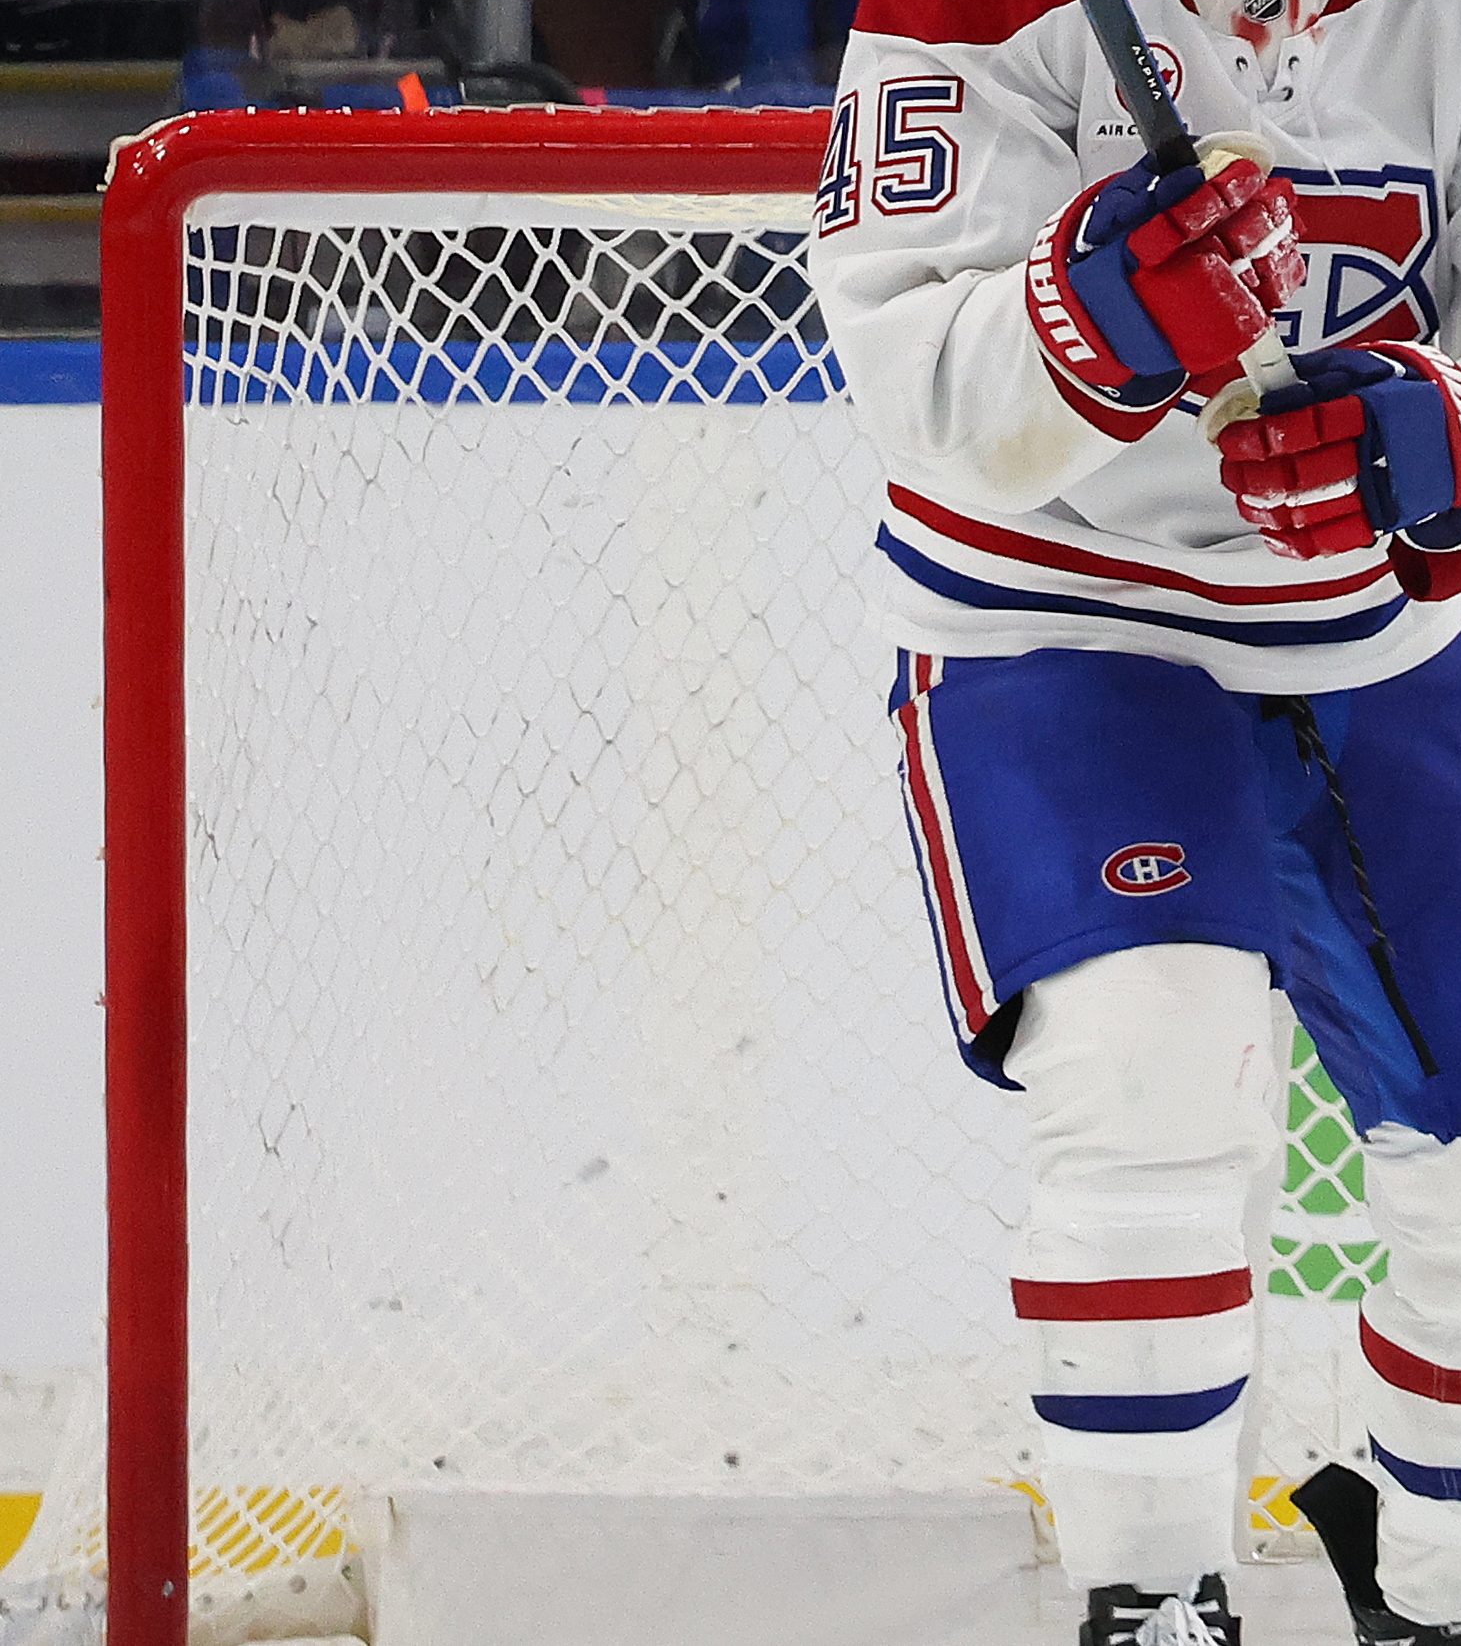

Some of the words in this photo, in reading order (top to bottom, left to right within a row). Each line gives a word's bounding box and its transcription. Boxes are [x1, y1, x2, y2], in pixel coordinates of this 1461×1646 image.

[1131, 44, 1162, 102] ALPHA
[814, 75, 964, 239] 45
[1096, 122, 1126, 136] AIR
